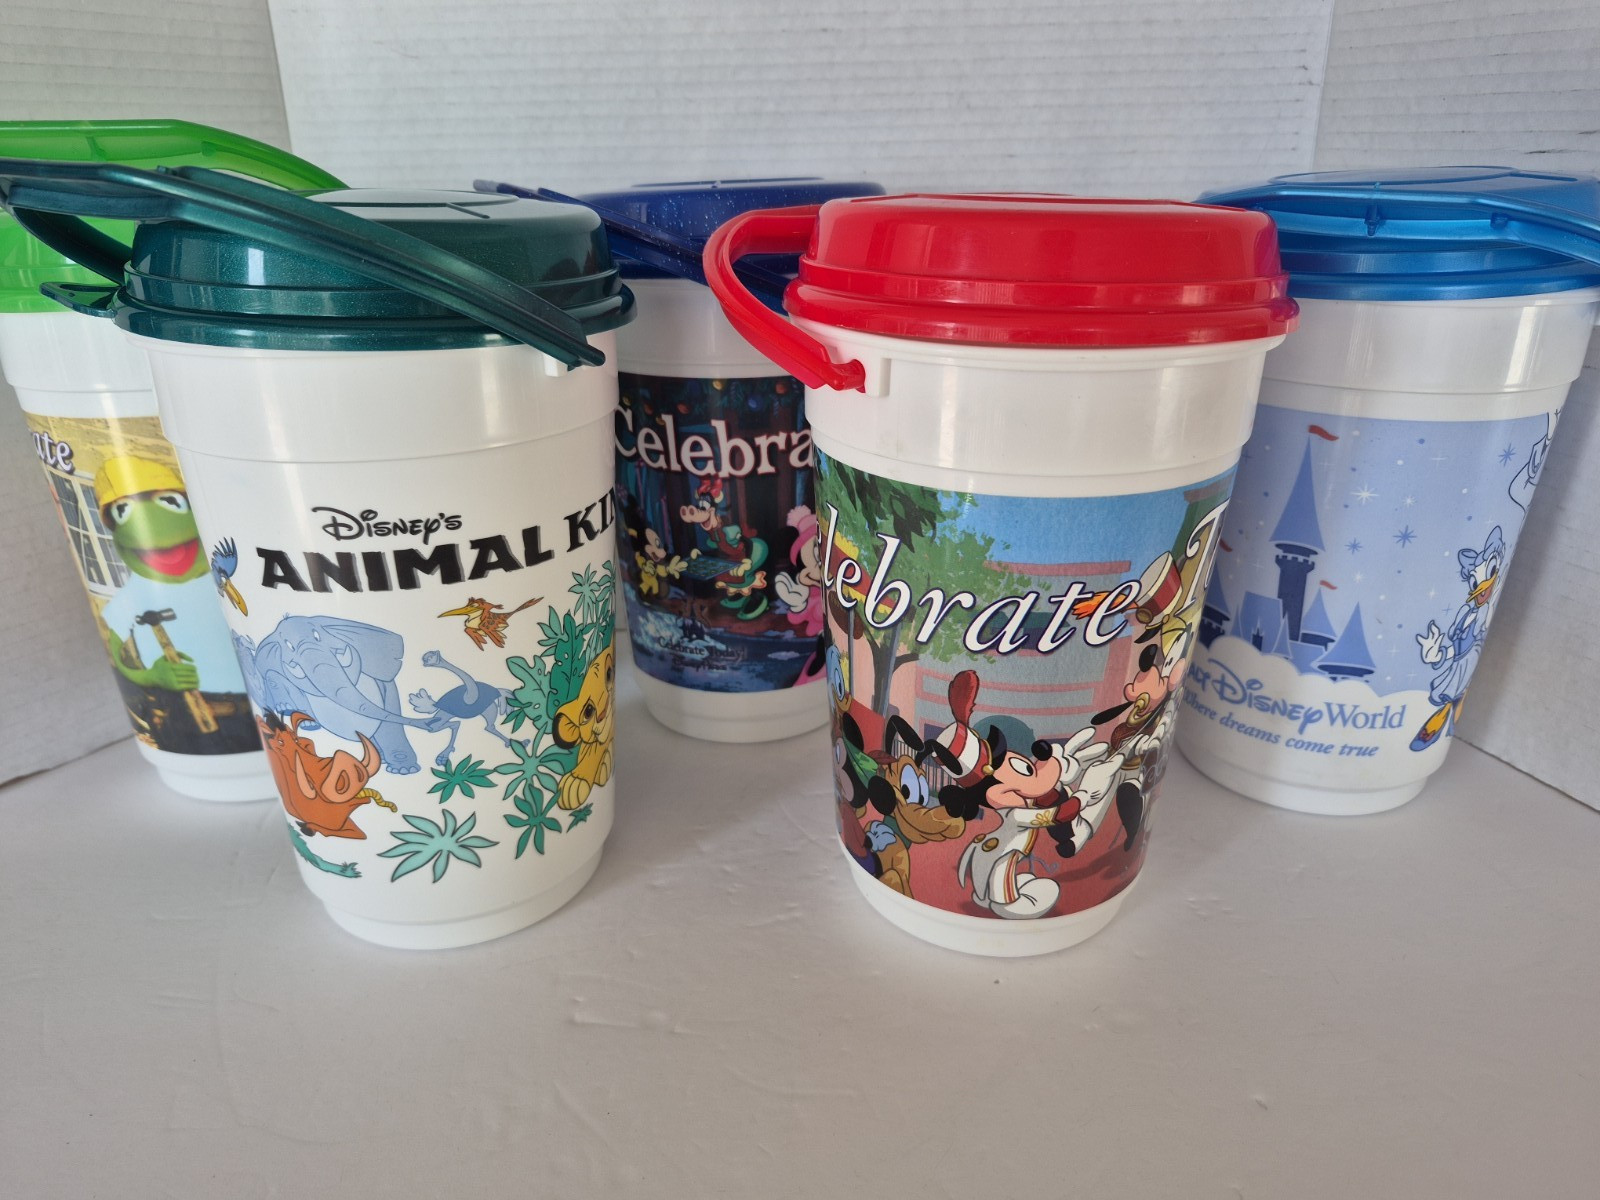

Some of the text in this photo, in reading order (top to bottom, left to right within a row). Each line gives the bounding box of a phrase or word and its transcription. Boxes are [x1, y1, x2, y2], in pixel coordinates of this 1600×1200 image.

[614, 402, 814, 479] Celebra
[255, 525, 555, 593] ANIMAL
[311, 506, 463, 545] Disney's
[817, 500, 1143, 655] lebrate
[658, 635, 706, 657] Celebrate
[1186, 658, 1407, 735] ALT Disney World
[1219, 711, 1281, 744] dreams
[1285, 736, 1335, 755] come
[1338, 743, 1380, 757] true
